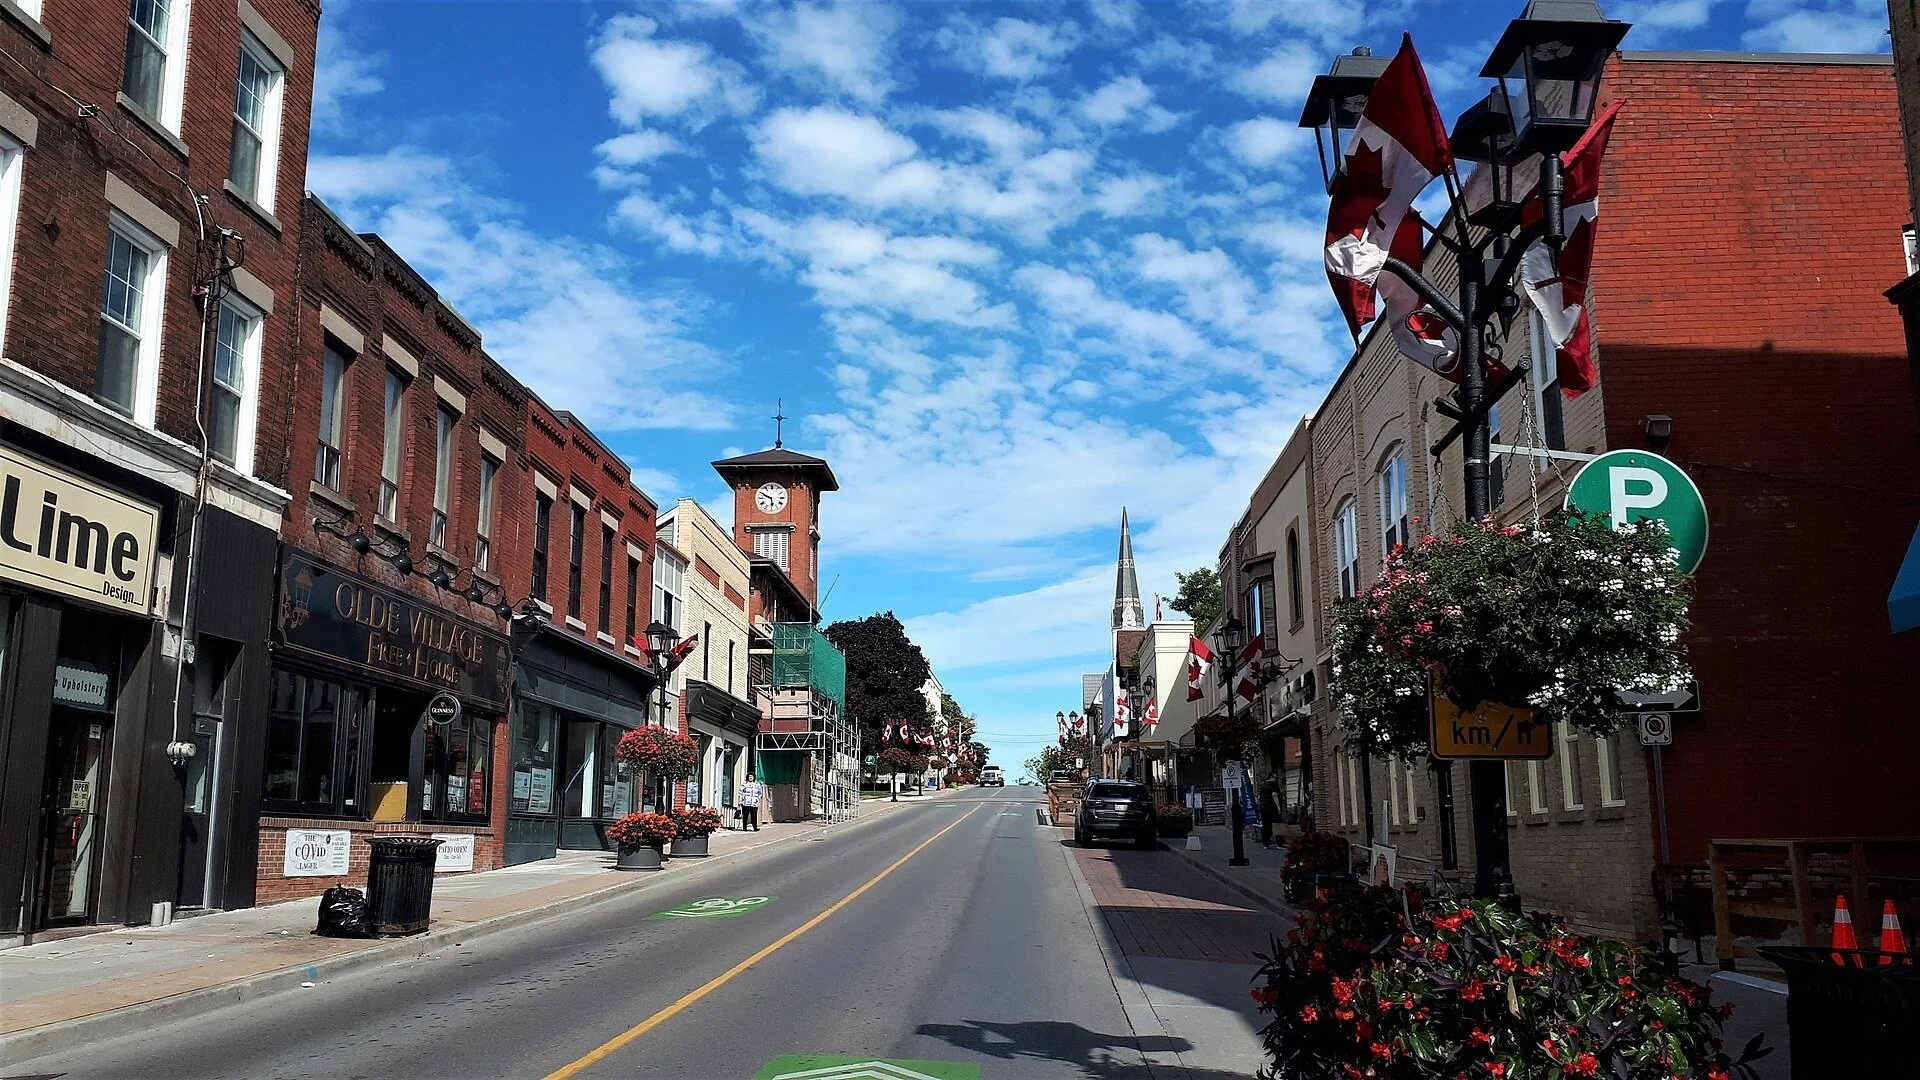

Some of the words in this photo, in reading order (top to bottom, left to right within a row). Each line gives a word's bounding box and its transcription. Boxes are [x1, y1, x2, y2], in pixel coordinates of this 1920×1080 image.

[0, 473, 140, 582] Lime
[102, 580, 135, 604] Design
[335, 582, 400, 635] OLDE
[407, 607, 483, 664] VILLAGE
[61, 677, 104, 697] Upholstery
[299, 862, 318, 870] LAGER
